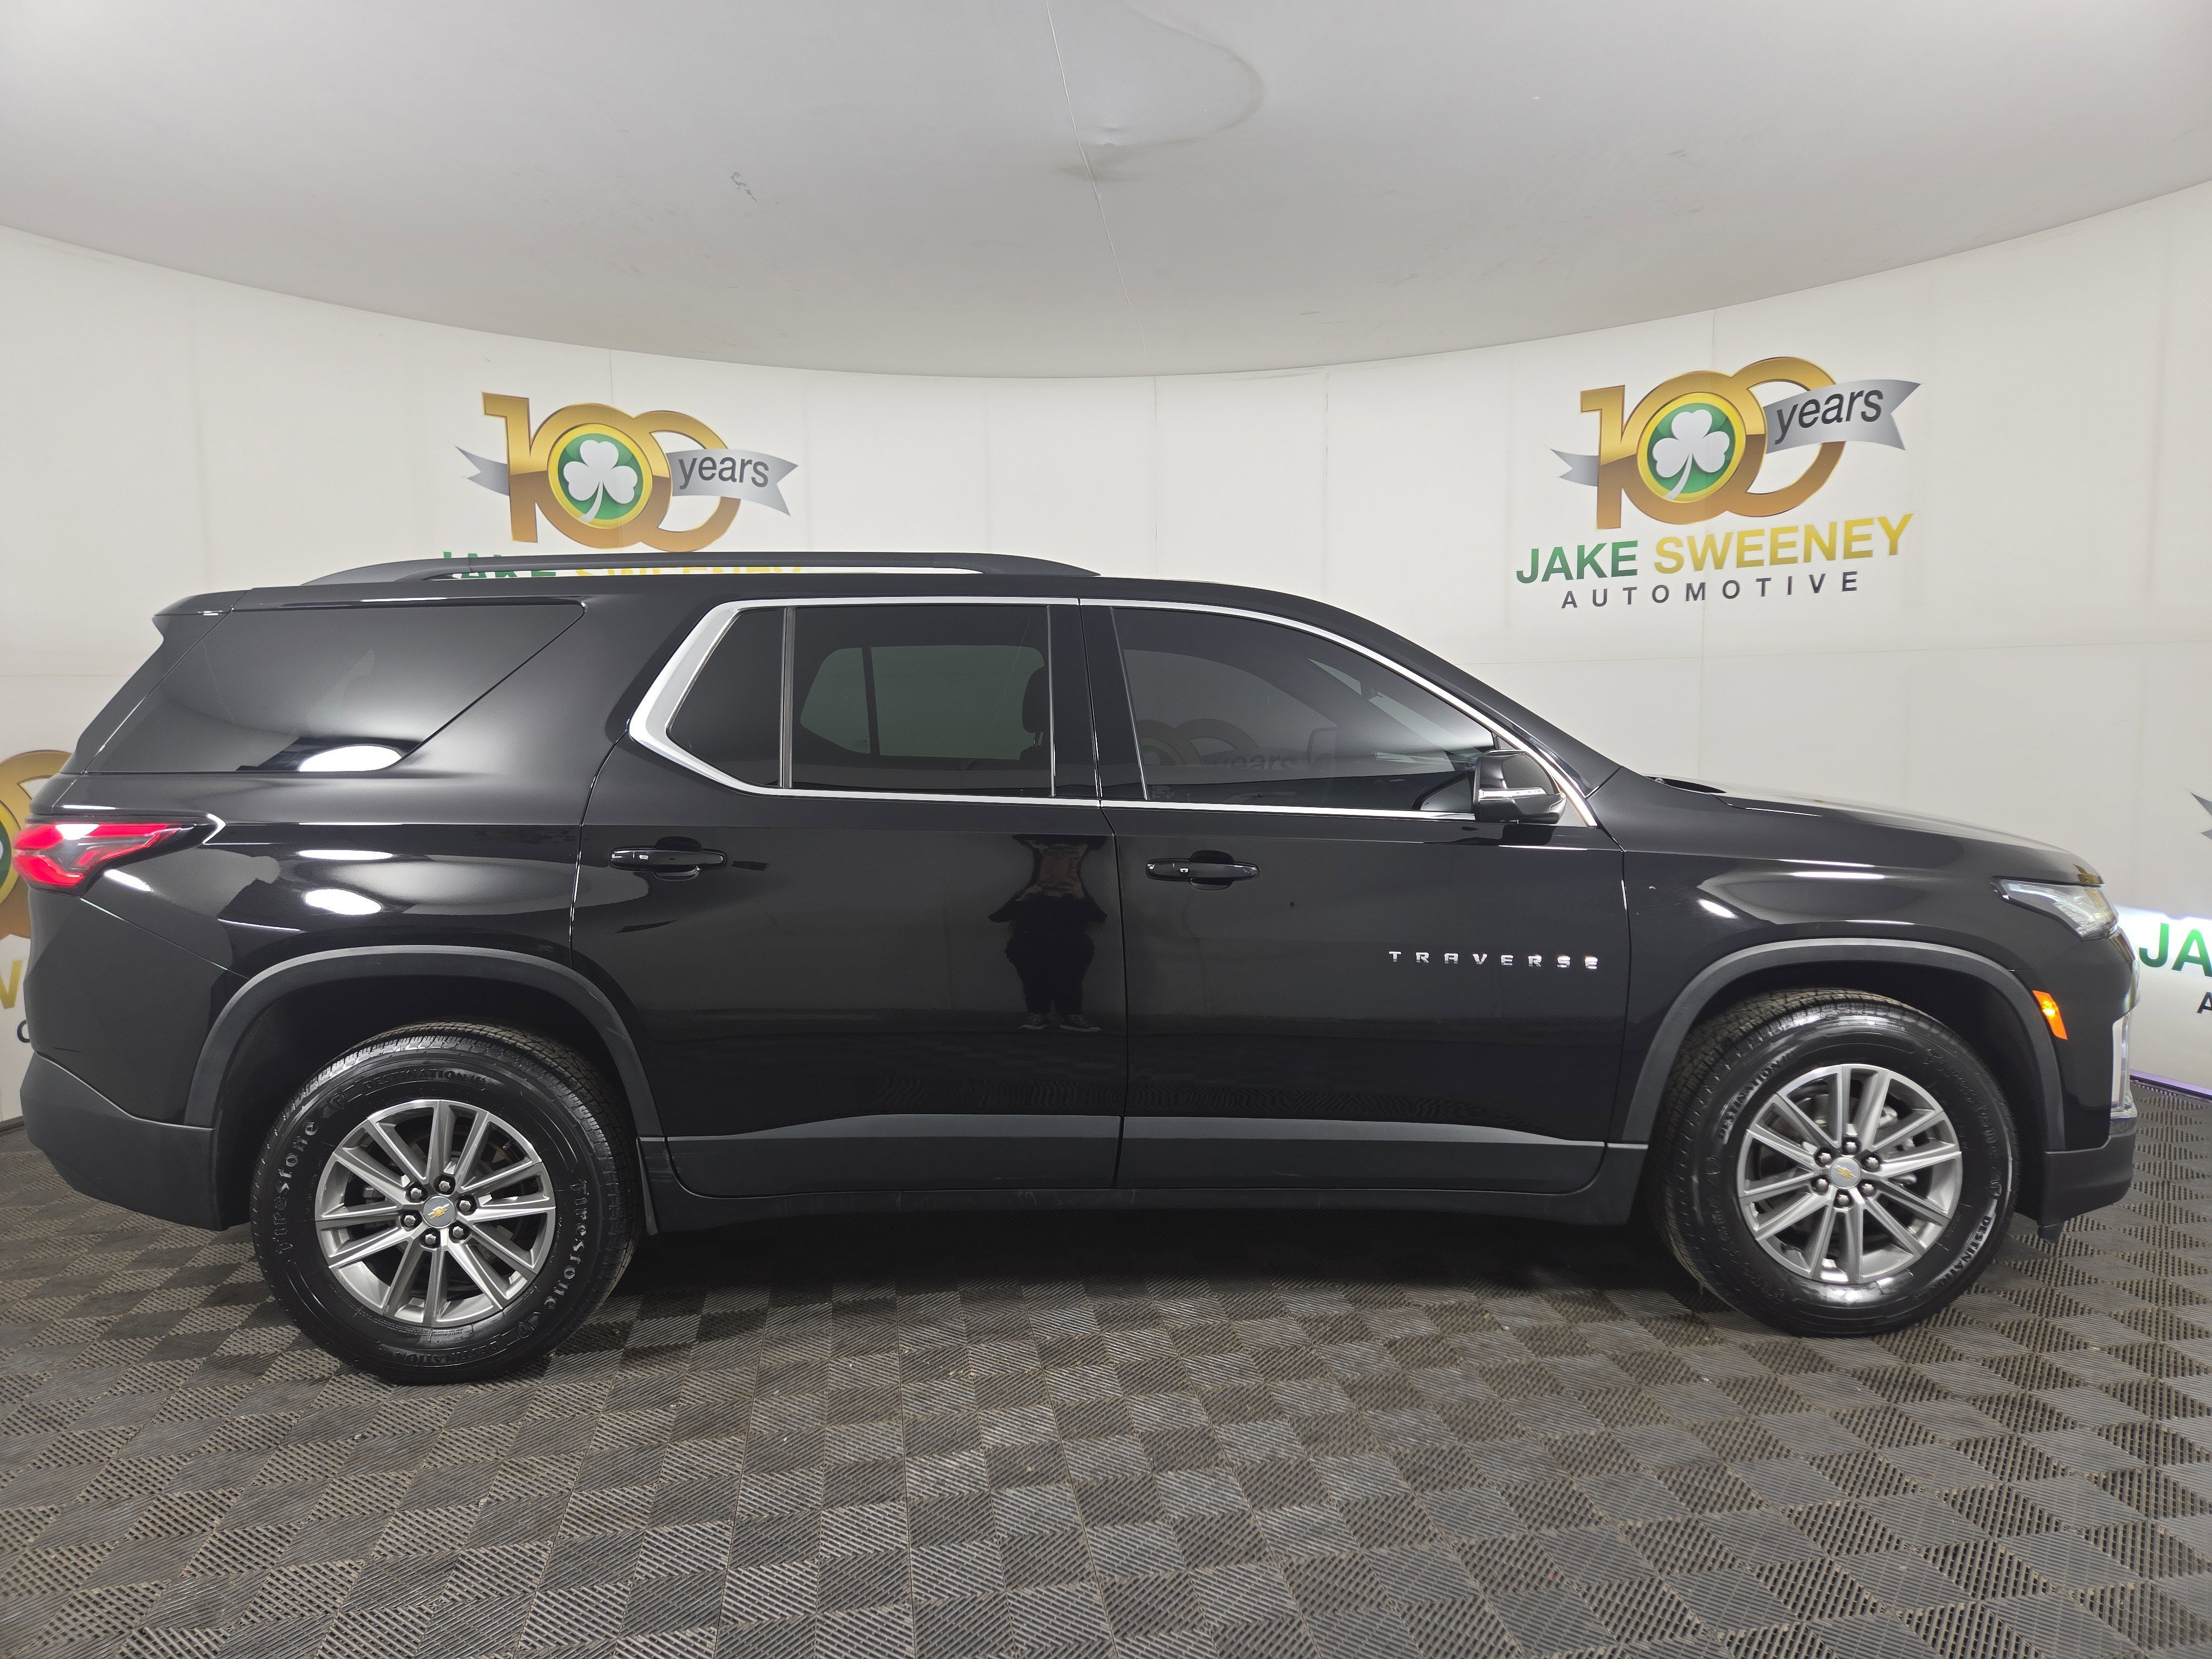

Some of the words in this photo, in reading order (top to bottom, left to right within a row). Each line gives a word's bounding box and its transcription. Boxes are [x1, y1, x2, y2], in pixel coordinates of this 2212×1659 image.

[1775, 388, 1884, 444] years
[678, 455, 769, 490] years
[1516, 540, 1638, 584] JAKE
[1654, 513, 1914, 575] SWEENEY
[1561, 570, 1859, 609] AUTOMOTIVE
[1388, 950, 1598, 970] TRAVERSE
[272, 1121, 318, 1256] Firestone
[544, 1179, 590, 1310] Firestone
